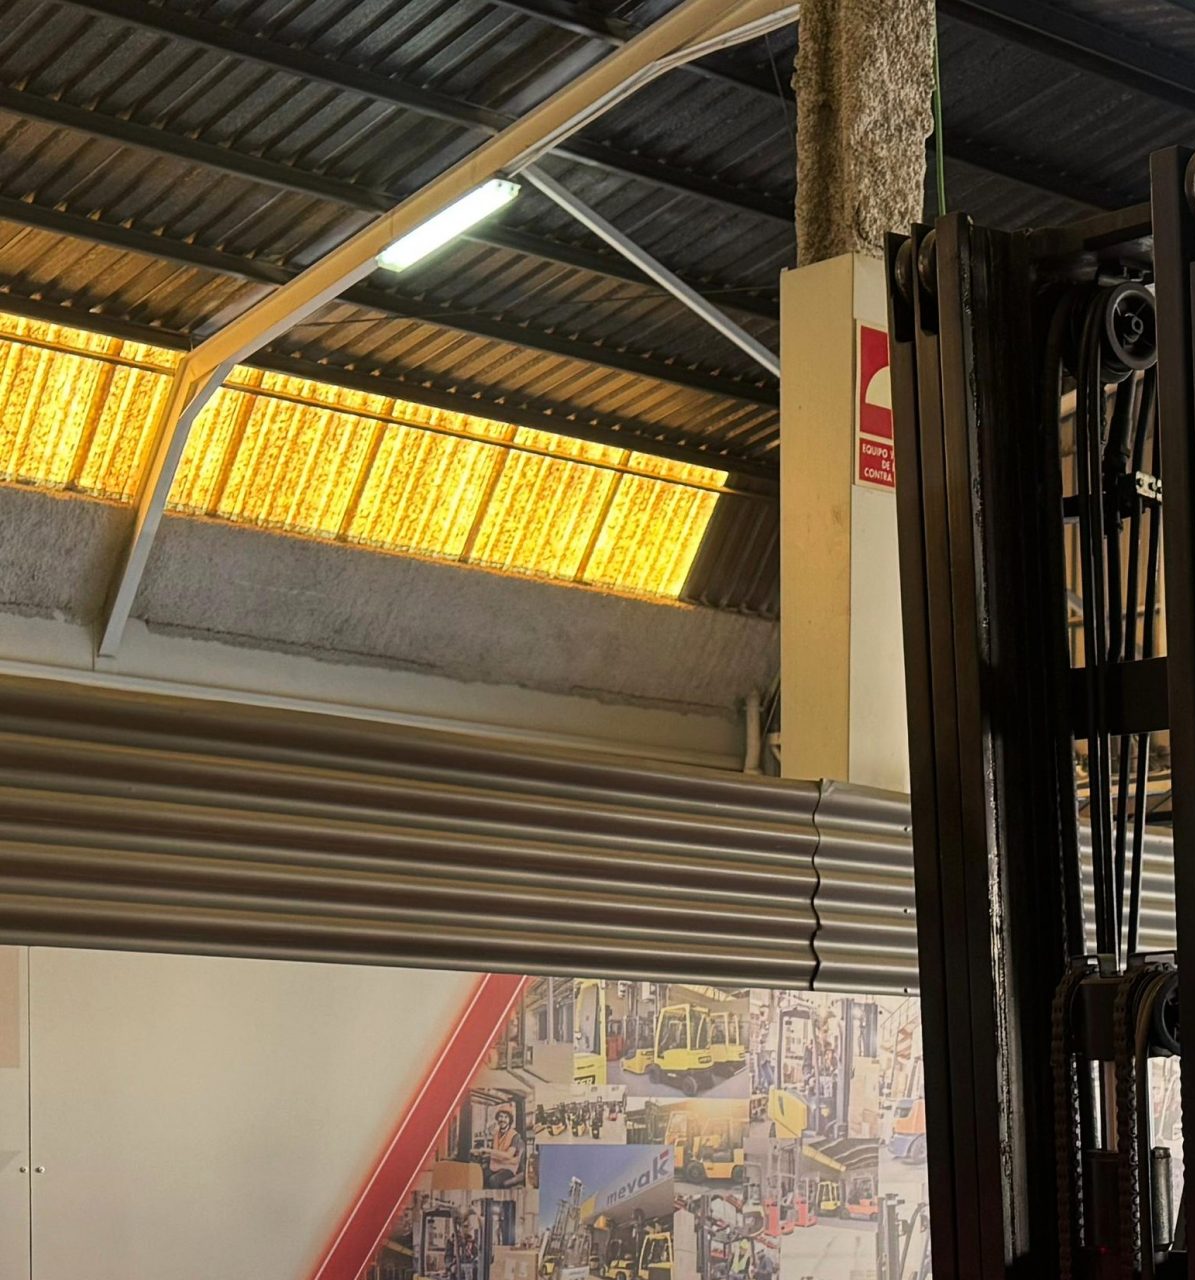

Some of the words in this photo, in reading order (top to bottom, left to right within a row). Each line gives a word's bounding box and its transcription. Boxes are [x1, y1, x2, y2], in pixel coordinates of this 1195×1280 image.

[862, 444, 888, 458] EQUIPO
[881, 460, 891, 470] DE
[864, 467, 892, 482] CONTRA
[606, 1150, 670, 1206] mevak
